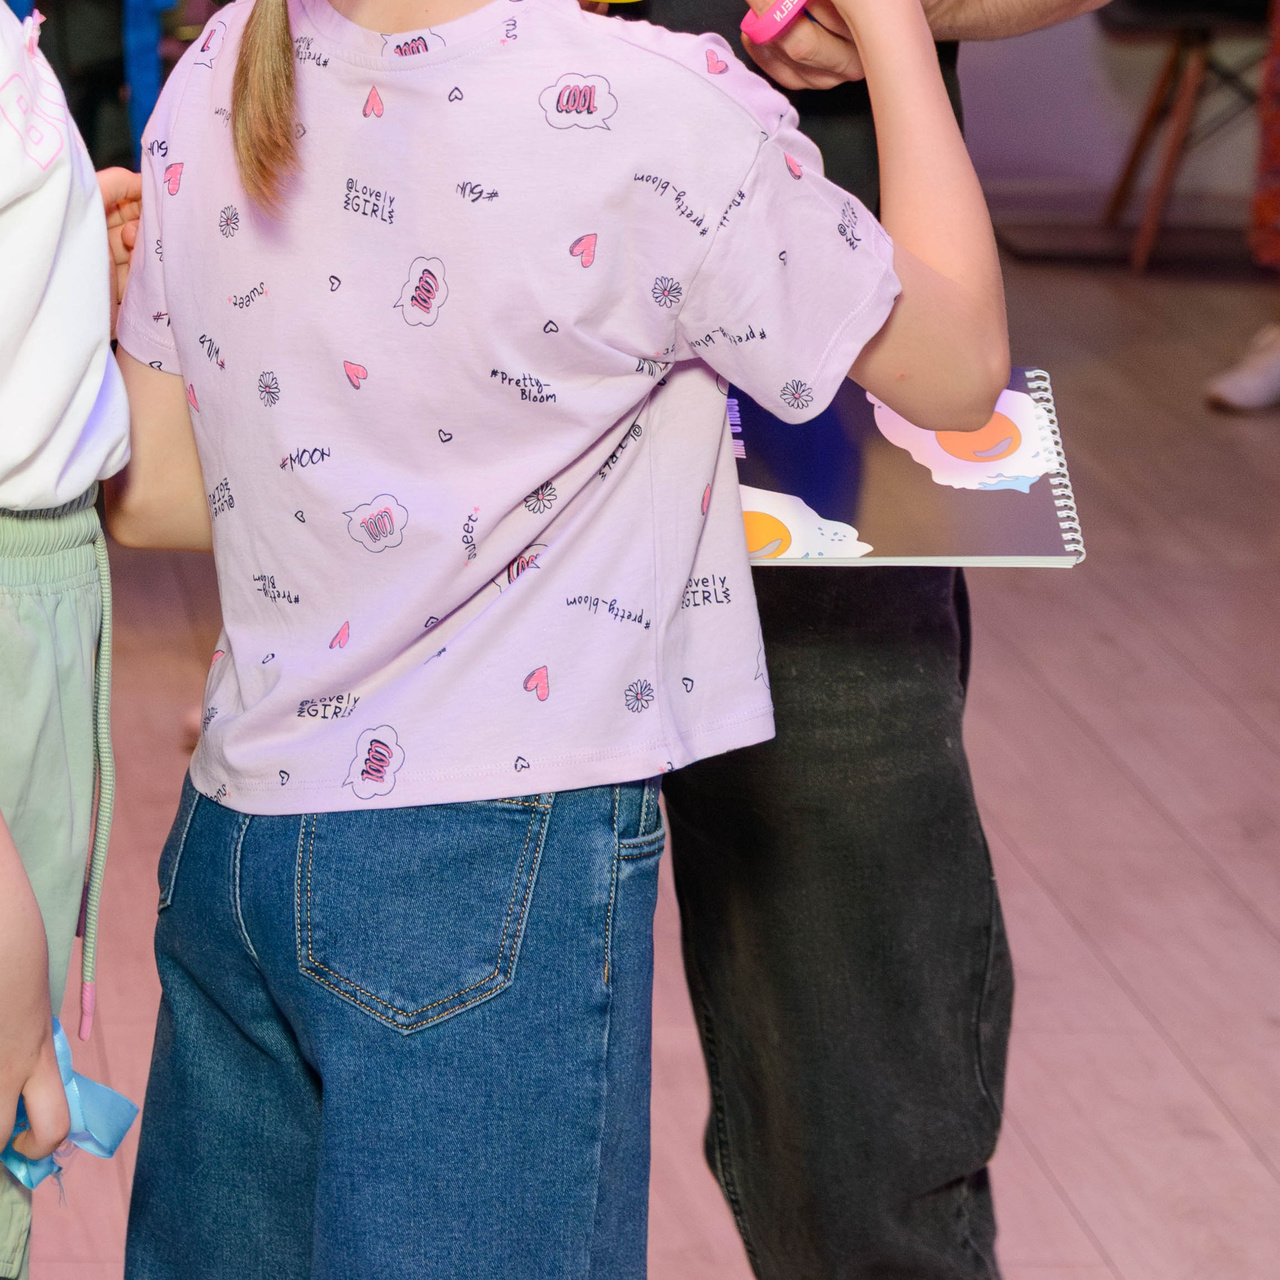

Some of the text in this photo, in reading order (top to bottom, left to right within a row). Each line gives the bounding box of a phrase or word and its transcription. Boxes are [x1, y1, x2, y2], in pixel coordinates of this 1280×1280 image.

[557, 84, 598, 114] COOL
[346, 178, 395, 207] @Lovely
[520, 388, 556, 403] Bloom
[280, 447, 331, 471] #MOON
